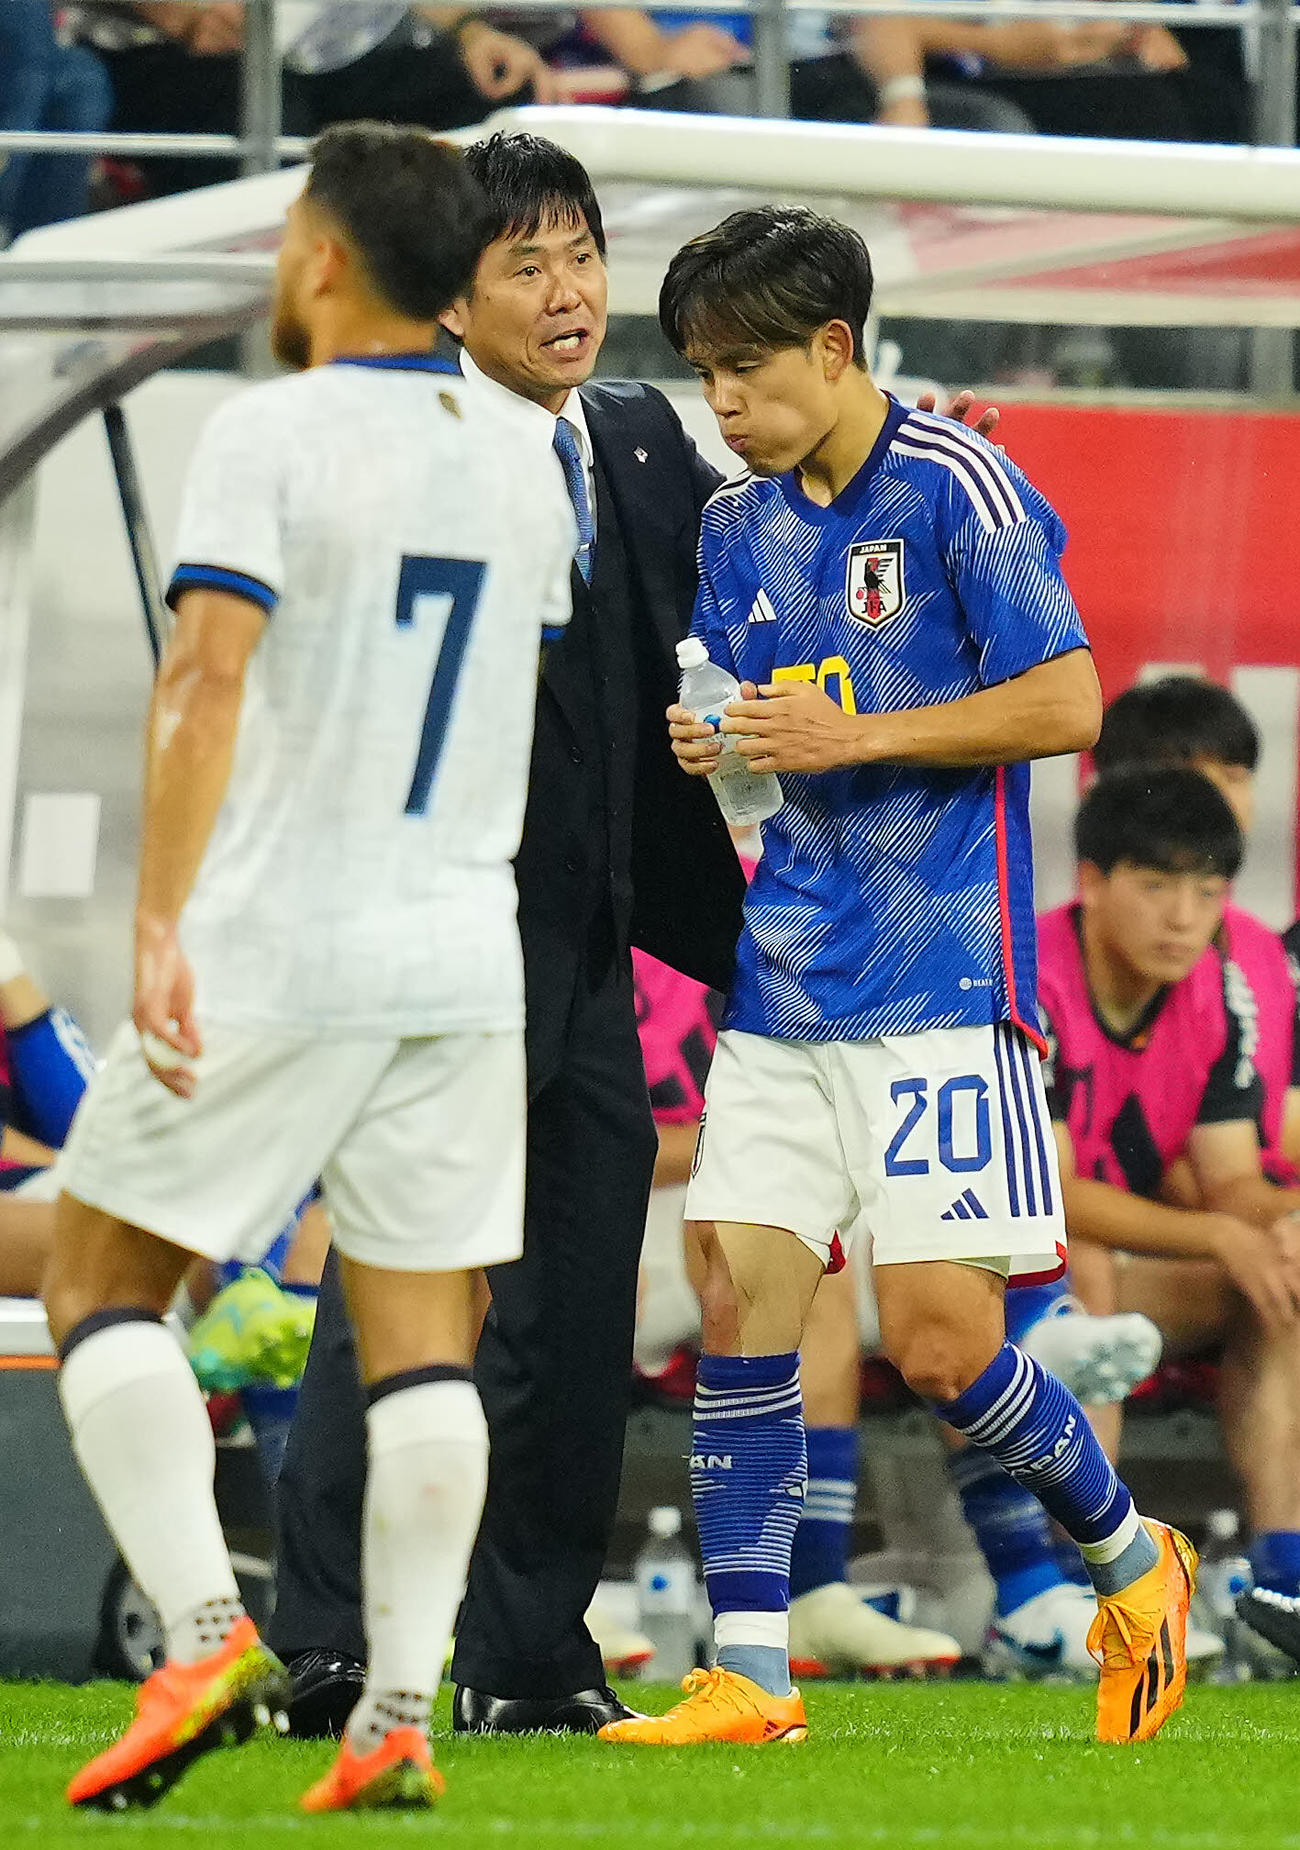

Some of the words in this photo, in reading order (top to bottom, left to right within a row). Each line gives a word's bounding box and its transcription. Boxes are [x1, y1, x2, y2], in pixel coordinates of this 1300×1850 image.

[860, 544, 888, 553] JAPAN
[861, 600, 887, 614] JFA
[395, 554, 487, 815] 7
[884, 1074, 993, 1177] 20
